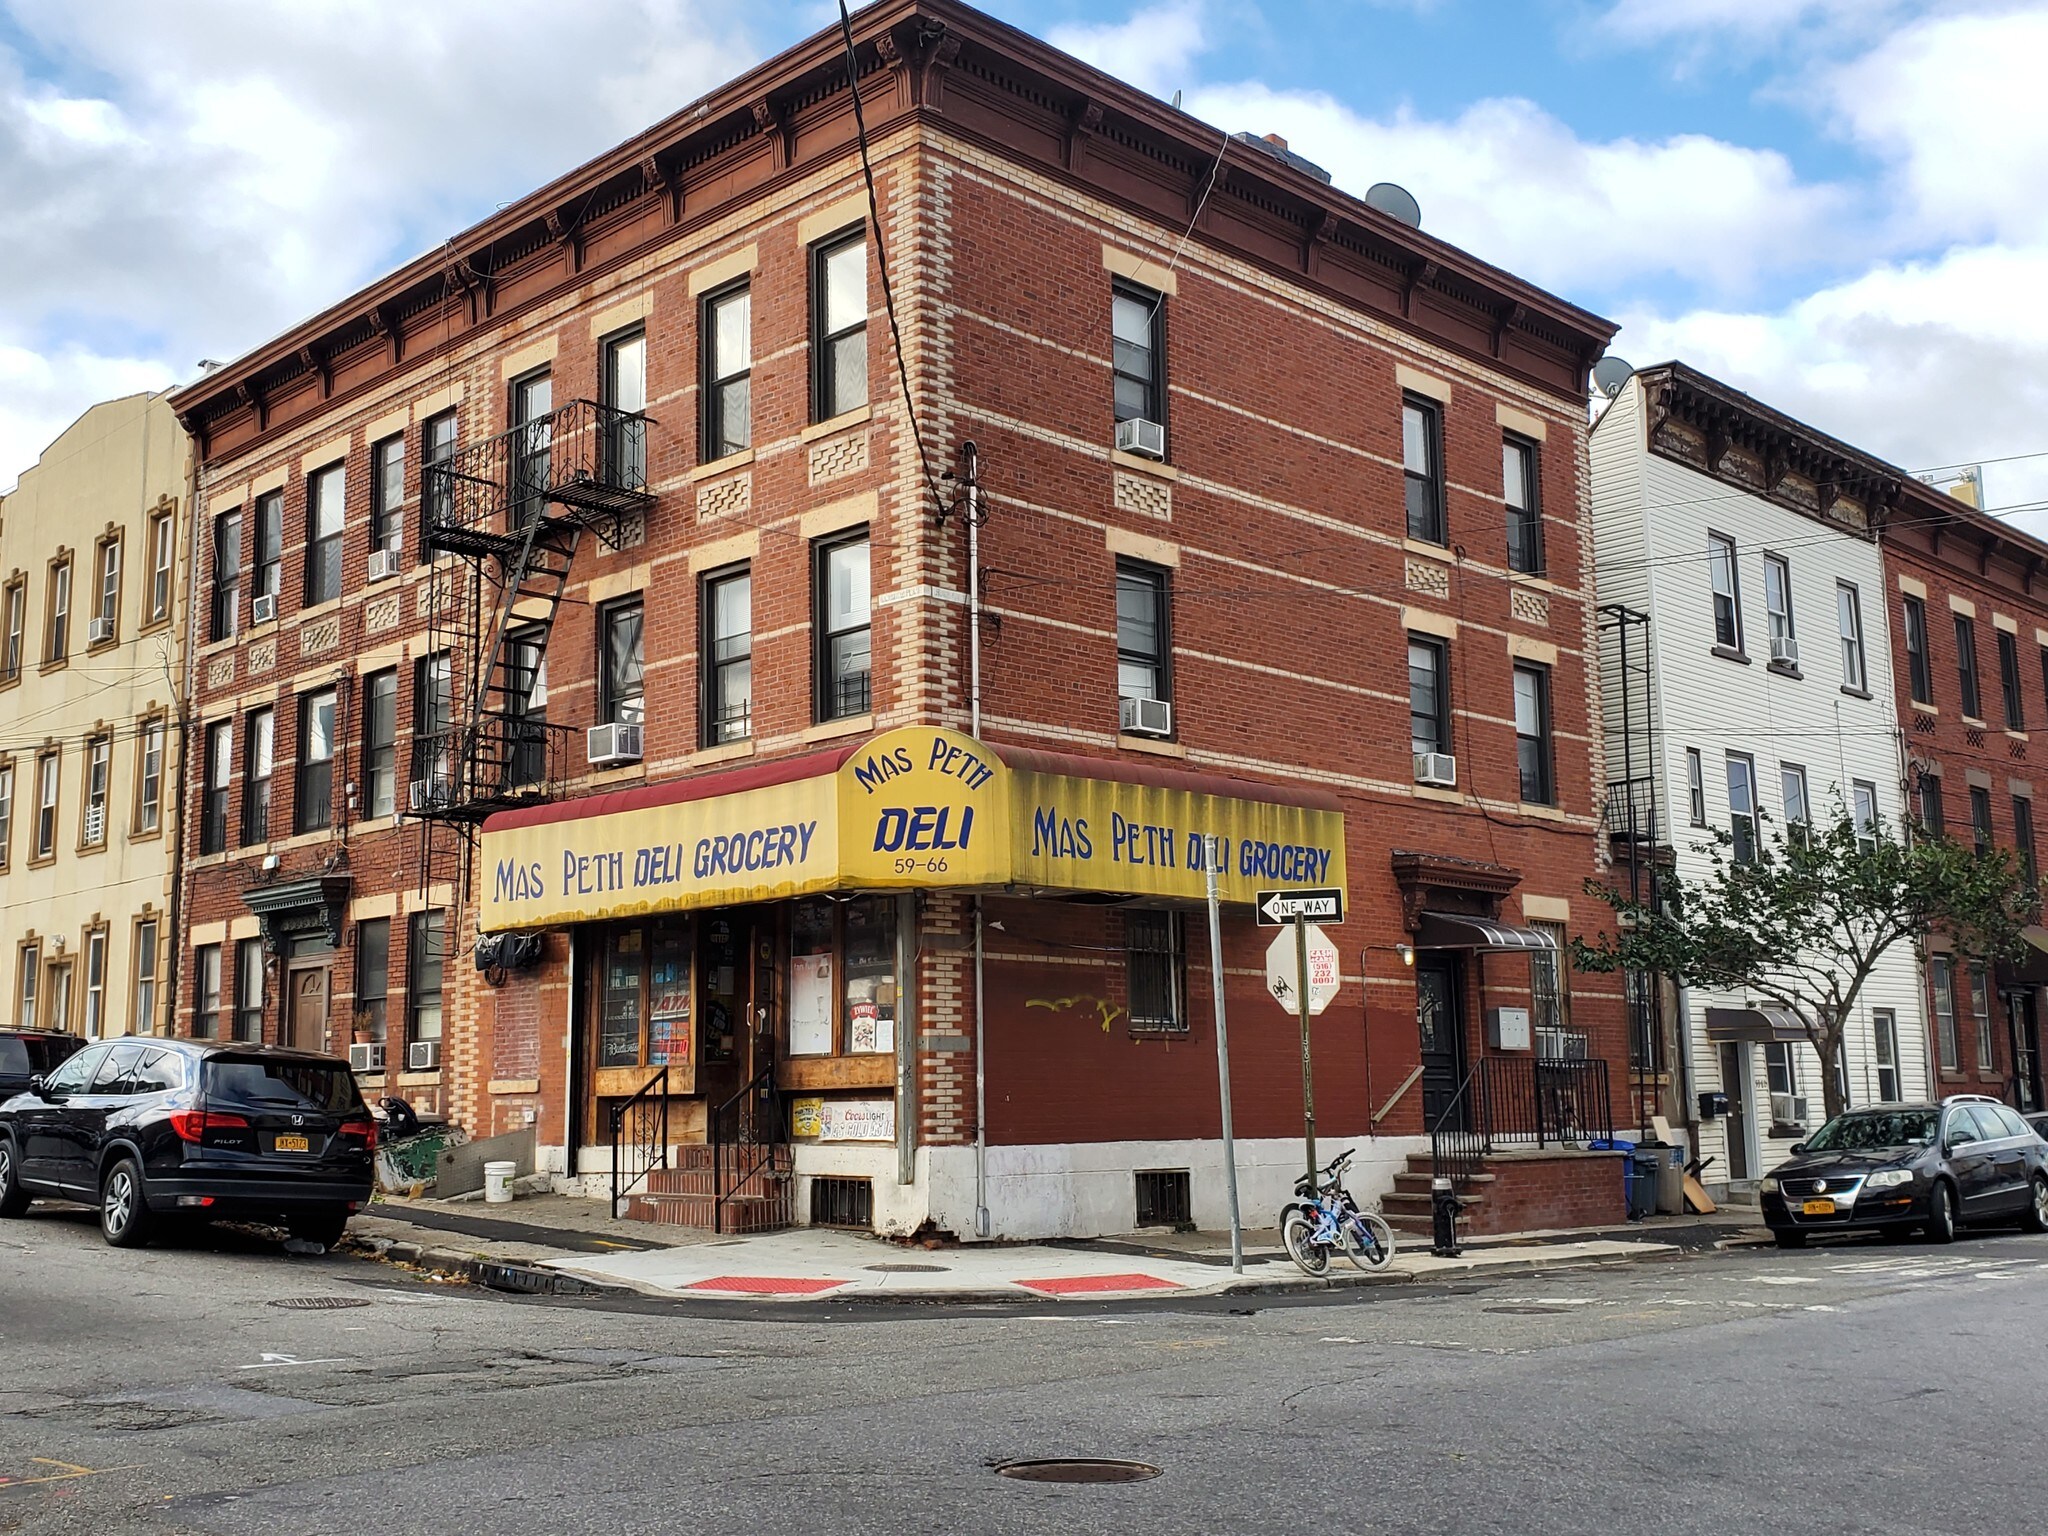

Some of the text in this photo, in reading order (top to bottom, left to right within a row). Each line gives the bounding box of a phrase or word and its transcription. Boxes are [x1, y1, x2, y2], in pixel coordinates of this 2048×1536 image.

[854, 737, 994, 795] MAS PETH
[872, 805, 974, 853] DELI
[1031, 805, 1093, 860] MAS
[1111, 811, 1176, 868] PETH
[1238, 838, 1332, 885] GROCERY
[493, 820, 817, 903] MAS PETH DELI GROCERY
[894, 857, 948, 874] 59-66
[1272, 900, 1330, 915] ONE WAY
[1313, 962, 1332, 970] (516)
[866, 1112, 885, 1121] LIGHT
